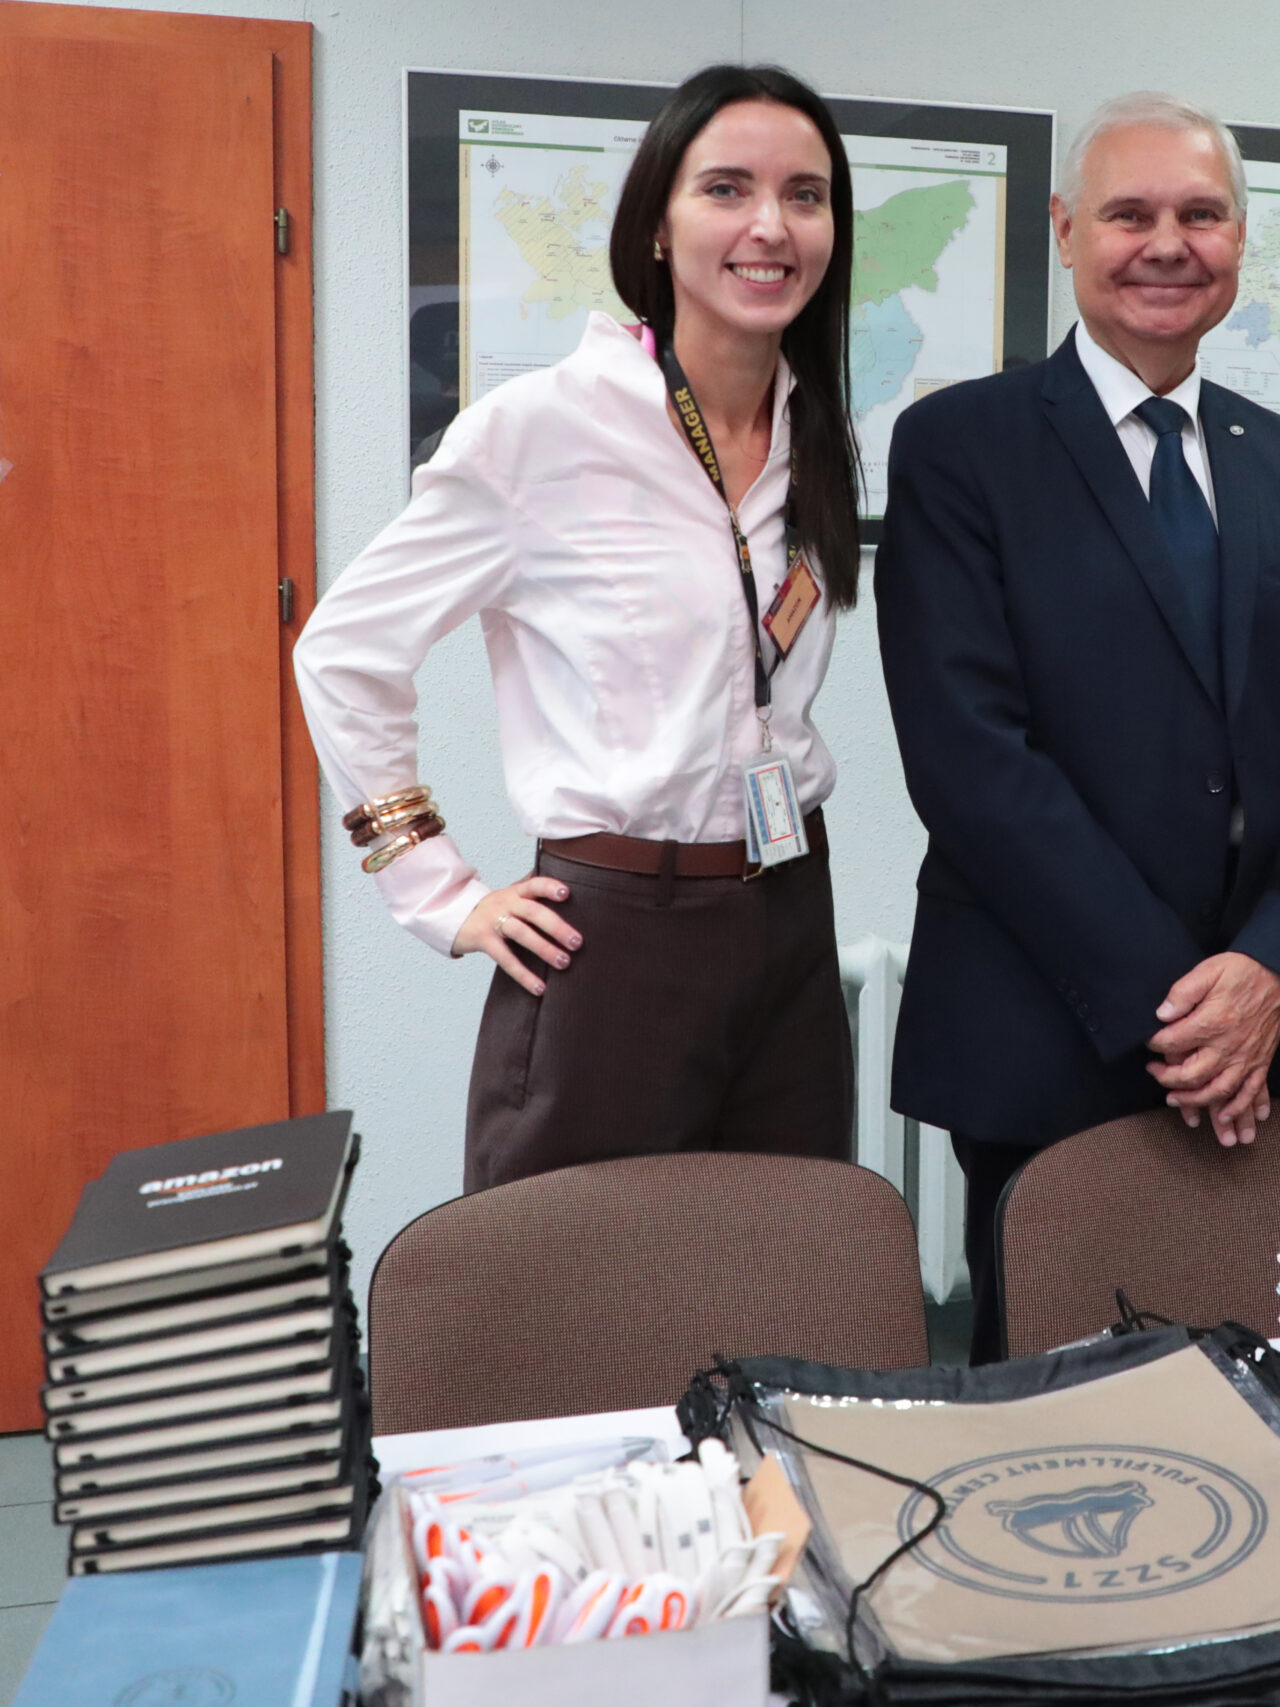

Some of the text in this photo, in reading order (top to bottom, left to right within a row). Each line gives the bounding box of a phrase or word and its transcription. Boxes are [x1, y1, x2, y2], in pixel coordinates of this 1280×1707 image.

[987, 151, 997, 166] 2
[674, 387, 720, 482] MANAGER
[138, 1158, 284, 1195] amazon
[1005, 1456, 1200, 1487] FULFILLMENT
[1062, 1554, 1192, 1589] SZZ1
